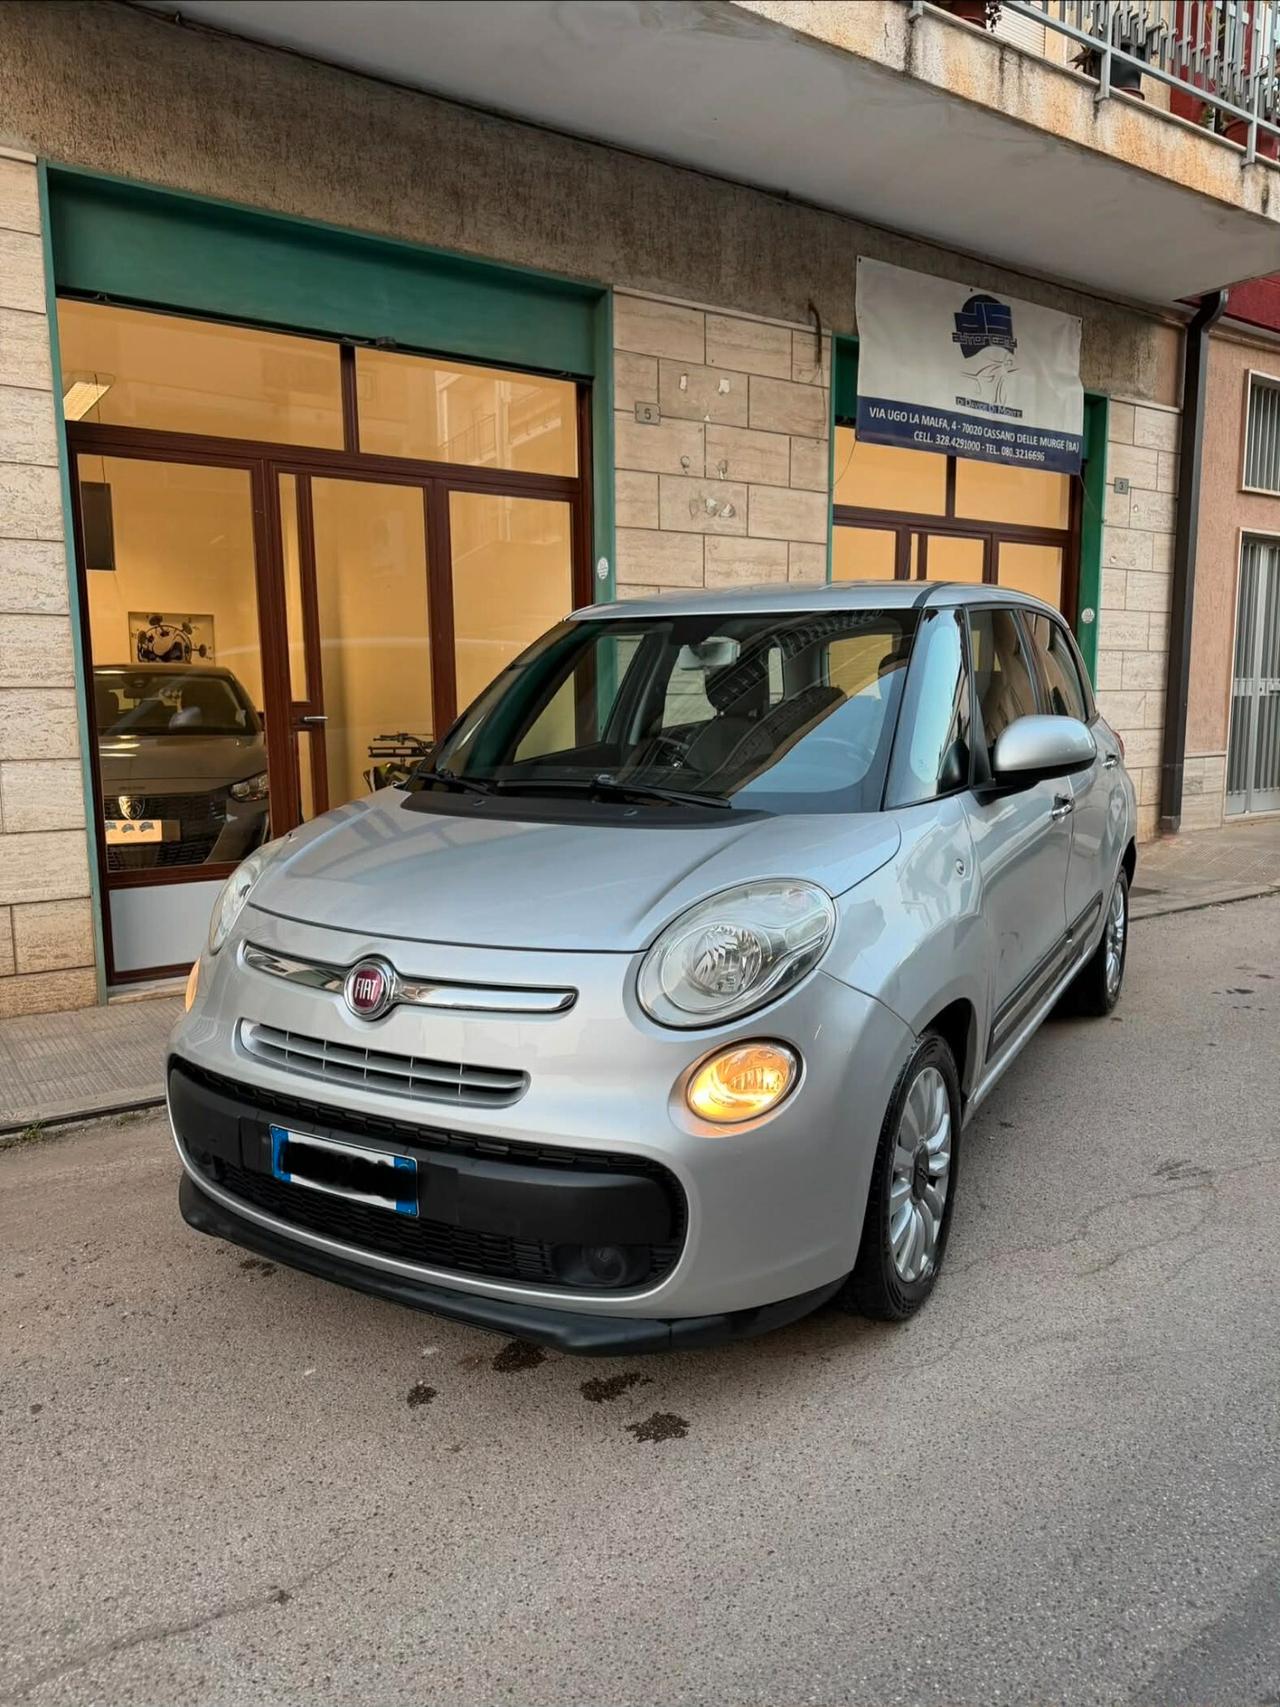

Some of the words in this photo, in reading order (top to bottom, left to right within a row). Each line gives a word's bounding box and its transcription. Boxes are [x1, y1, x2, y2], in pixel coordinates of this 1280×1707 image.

[644, 407, 651, 420] 5
[869, 407, 886, 419] VIA
[887, 409, 908, 422] UGO
[909, 414, 920, 424] LA
[921, 415, 950, 431] MALFA,
[951, 421, 957, 430] 4
[962, 423, 983, 436] 70020
[983, 427, 1016, 442] CASSANO
[1016, 433, 1038, 446] DELLE
[1039, 436, 1065, 450] MURGE
[1065, 440, 1080, 454] (BA)
[913, 430, 934, 443] CELL.
[935, 434, 981, 451] 328.4291000
[985, 443, 1000, 455] TEL.
[1001, 446, 1045, 462] 080.3216696
[354, 977, 378, 1001] FIAT
